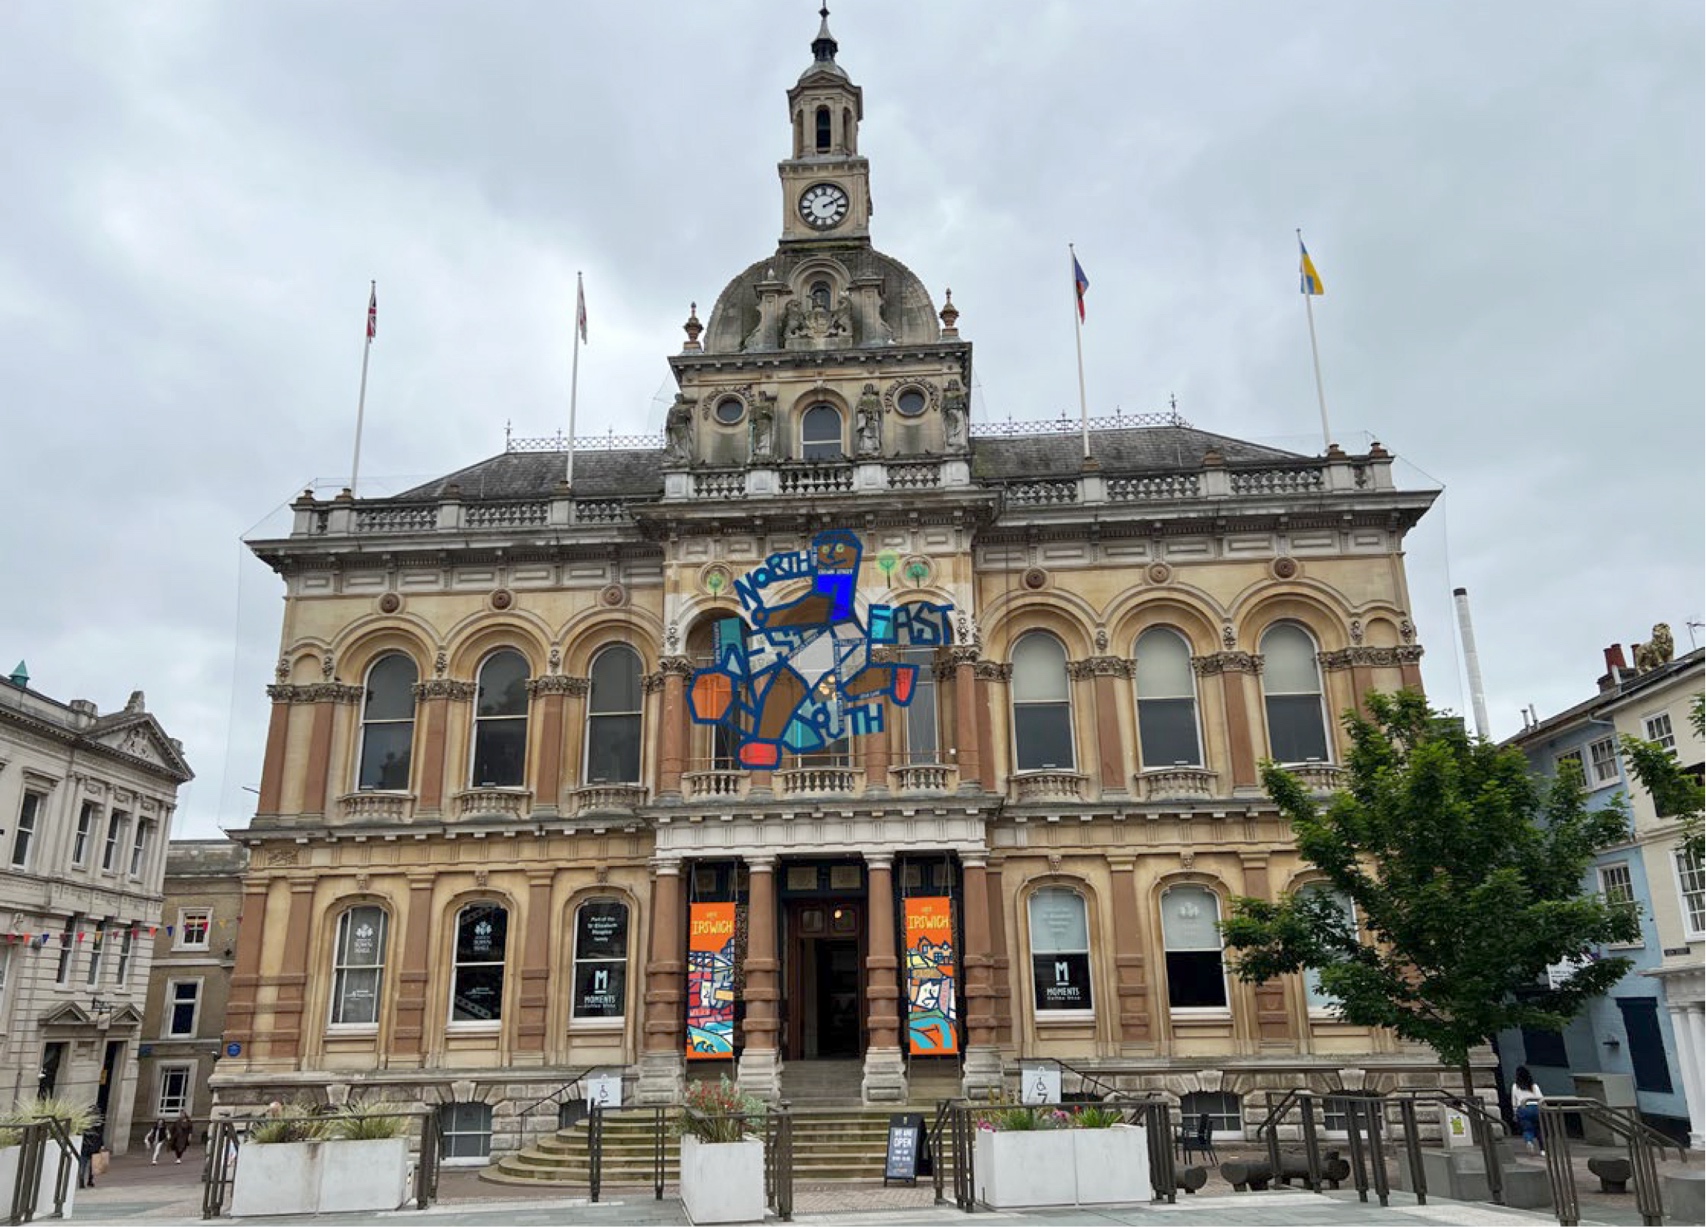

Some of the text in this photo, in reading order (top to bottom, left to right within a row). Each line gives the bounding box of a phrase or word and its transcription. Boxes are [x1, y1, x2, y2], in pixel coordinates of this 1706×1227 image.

[733, 550, 816, 612] NORTH
[868, 600, 954, 645] EAST
[692, 920, 733, 936] IPSWICH
[908, 915, 949, 930] IPSWICH
[1055, 962, 1069, 981] M
[594, 970, 608, 990] M
[584, 995, 616, 1004] MOMENTS
[1046, 987, 1080, 996] MOMENTS
[893, 1137, 912, 1148] OPEN
